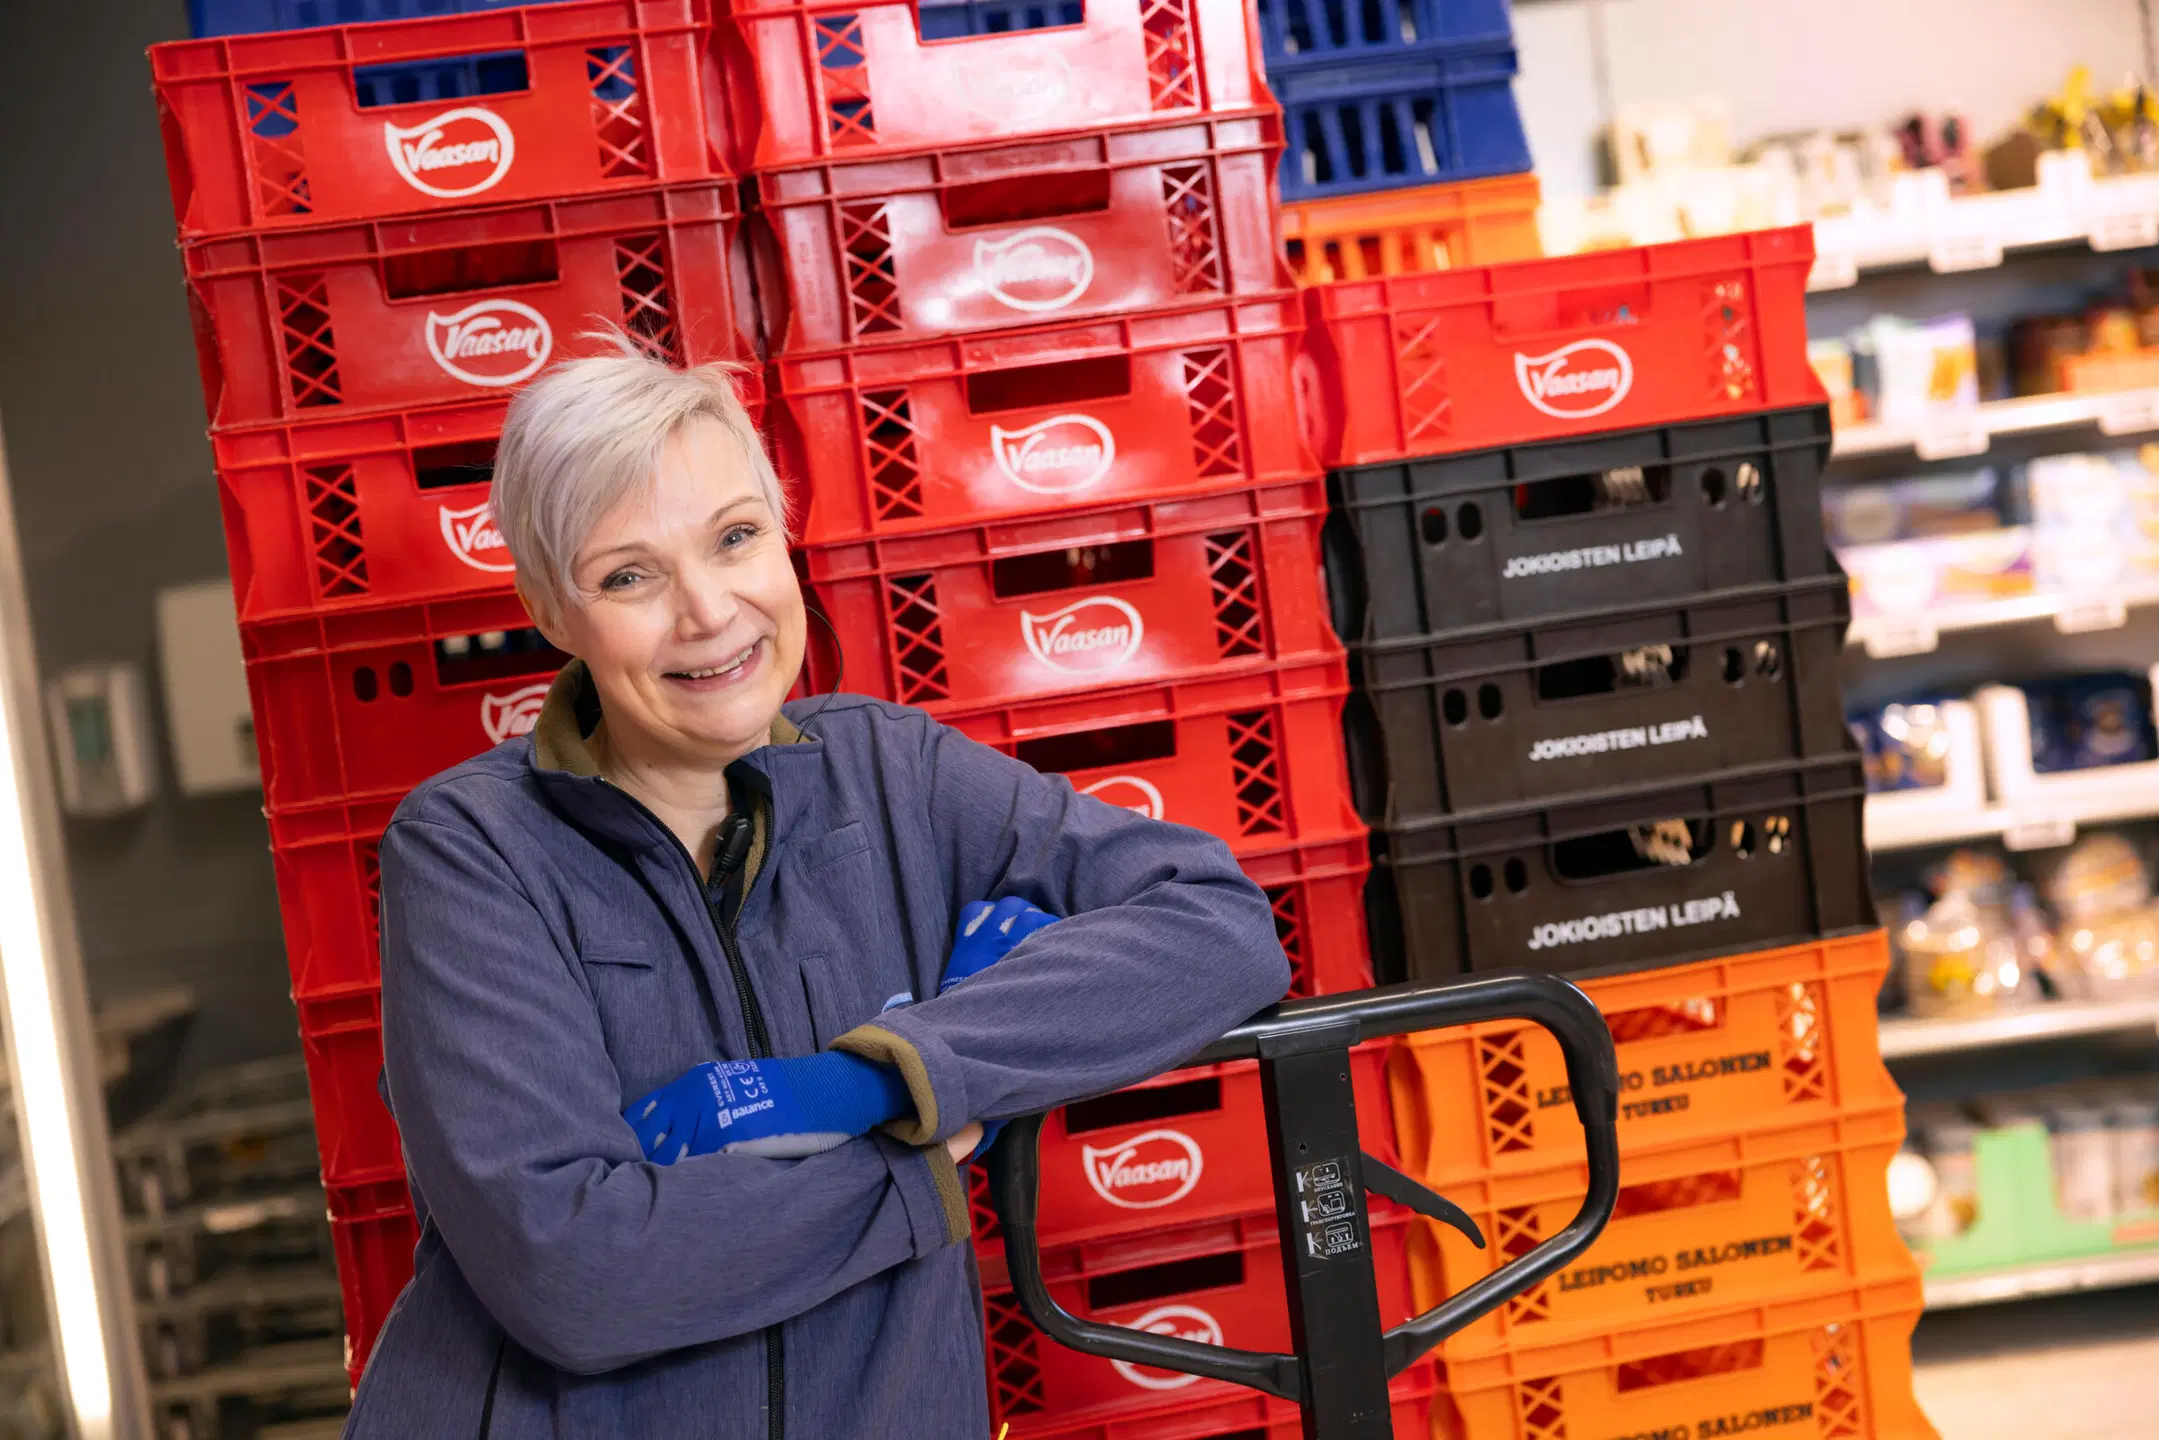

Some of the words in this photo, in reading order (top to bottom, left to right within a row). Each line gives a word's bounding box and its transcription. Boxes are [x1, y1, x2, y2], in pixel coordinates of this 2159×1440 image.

[403, 129, 499, 172] Vaasan
[444, 316, 540, 359] Vaasan
[1530, 357, 1619, 399] Vaasan
[456, 510, 507, 553] Vaa
[1502, 544, 1621, 578] JOKIOISTEN
[1623, 532, 1683, 562] LEIPÄ
[1037, 614, 1130, 655] Vaasan
[1528, 726, 1647, 761] JOKIOISTEN
[1648, 715, 1708, 744] LEIPÄ
[1527, 905, 1668, 950] JOKIOISTEN
[1669, 890, 1741, 926] LEIPÄ
[1651, 1050, 1772, 1087] SALONEN
[707, 1073, 725, 1108] EVEREST
[1622, 1092, 1690, 1121] TURKU
[1098, 1148, 1189, 1190] Vaasan
[1325, 1241, 1359, 1256] ПОДЪЕМ
[1558, 1255, 1669, 1293] LEIPOMO
[1675, 1234, 1793, 1271] SALONEN
[1644, 1276, 1713, 1305] TURKU
[1697, 1402, 1814, 1439] SALONEN
